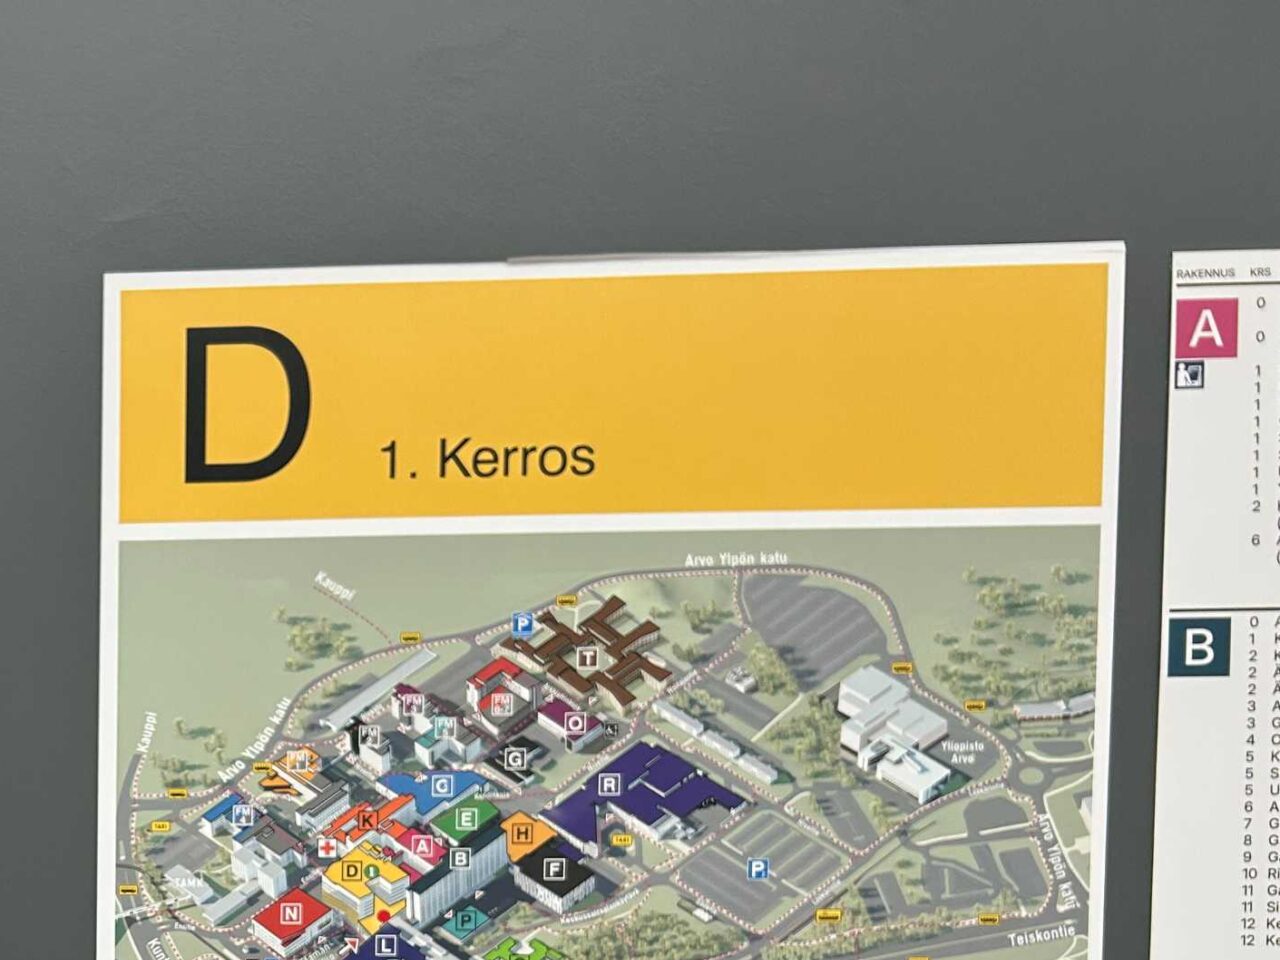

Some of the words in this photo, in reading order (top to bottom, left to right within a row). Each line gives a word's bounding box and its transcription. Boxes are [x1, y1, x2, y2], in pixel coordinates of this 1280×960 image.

[1176, 267, 1236, 278] RAKENNUS
[1250, 266, 1272, 277] KRS
[1189, 308, 1224, 348] A
[1256, 296, 1266, 309] 0
[1256, 331, 1265, 343] 0
[1255, 365, 1261, 377] 1
[1254, 381, 1260, 393] 1
[183, 325, 312, 484] D
[1254, 415, 1260, 427] 1
[380, 441, 420, 480] 1.
[439, 437, 596, 480] Kerros
[1253, 449, 1259, 461] 1
[1253, 466, 1259, 478] 1
[1252, 483, 1258, 495] 1
[1252, 500, 1260, 512] 2
[1251, 534, 1260, 546] 6
[685, 552, 715, 566] Arvo
[718, 551, 755, 567] Ylpön
[759, 550, 788, 565] katu
[314, 570, 356, 602] Kauppi
[1185, 627, 1215, 666] B
[1249, 615, 1259, 628] 0
[1249, 633, 1255, 645] 1
[582, 650, 594, 665] T
[1249, 650, 1258, 662] 2
[1248, 666, 1257, 678] 2
[1248, 683, 1257, 695] 2
[1247, 700, 1256, 712] 3
[568, 715, 583, 731] O
[1246, 716, 1255, 729] 3
[136, 711, 158, 753] Kauppi
[217, 760, 246, 783] Arvo
[241, 726, 276, 759] Ylpön
[268, 697, 293, 725] katu
[1246, 734, 1255, 745] 4
[941, 739, 985, 753] Yliopisto
[508, 752, 522, 766] G
[1245, 750, 1254, 762] 5
[1245, 767, 1253, 779] 5
[603, 777, 616, 791] R
[1244, 784, 1253, 796] 5
[1244, 800, 1253, 813] 6
[362, 814, 373, 828] K
[461, 812, 473, 827] E
[1243, 817, 1252, 829] 7
[517, 826, 529, 841] H
[415, 839, 429, 852] A
[1243, 834, 1252, 846] 8
[455, 852, 467, 865] B
[1039, 813, 1054, 841] Arvo
[1047, 842, 1067, 879] Ylpön
[1059, 881, 1080, 909] katu
[1243, 851, 1252, 863] 9
[346, 864, 358, 878] D
[549, 861, 559, 876] F
[1242, 868, 1257, 880] 10
[1242, 884, 1253, 896] 11
[1241, 901, 1253, 913] 11
[285, 906, 298, 921] N
[461, 913, 471, 927] P
[1241, 918, 1255, 929] 12
[1008, 922, 1076, 948] Teiskontie
[1240, 935, 1255, 946] 12
[381, 938, 392, 953] L
